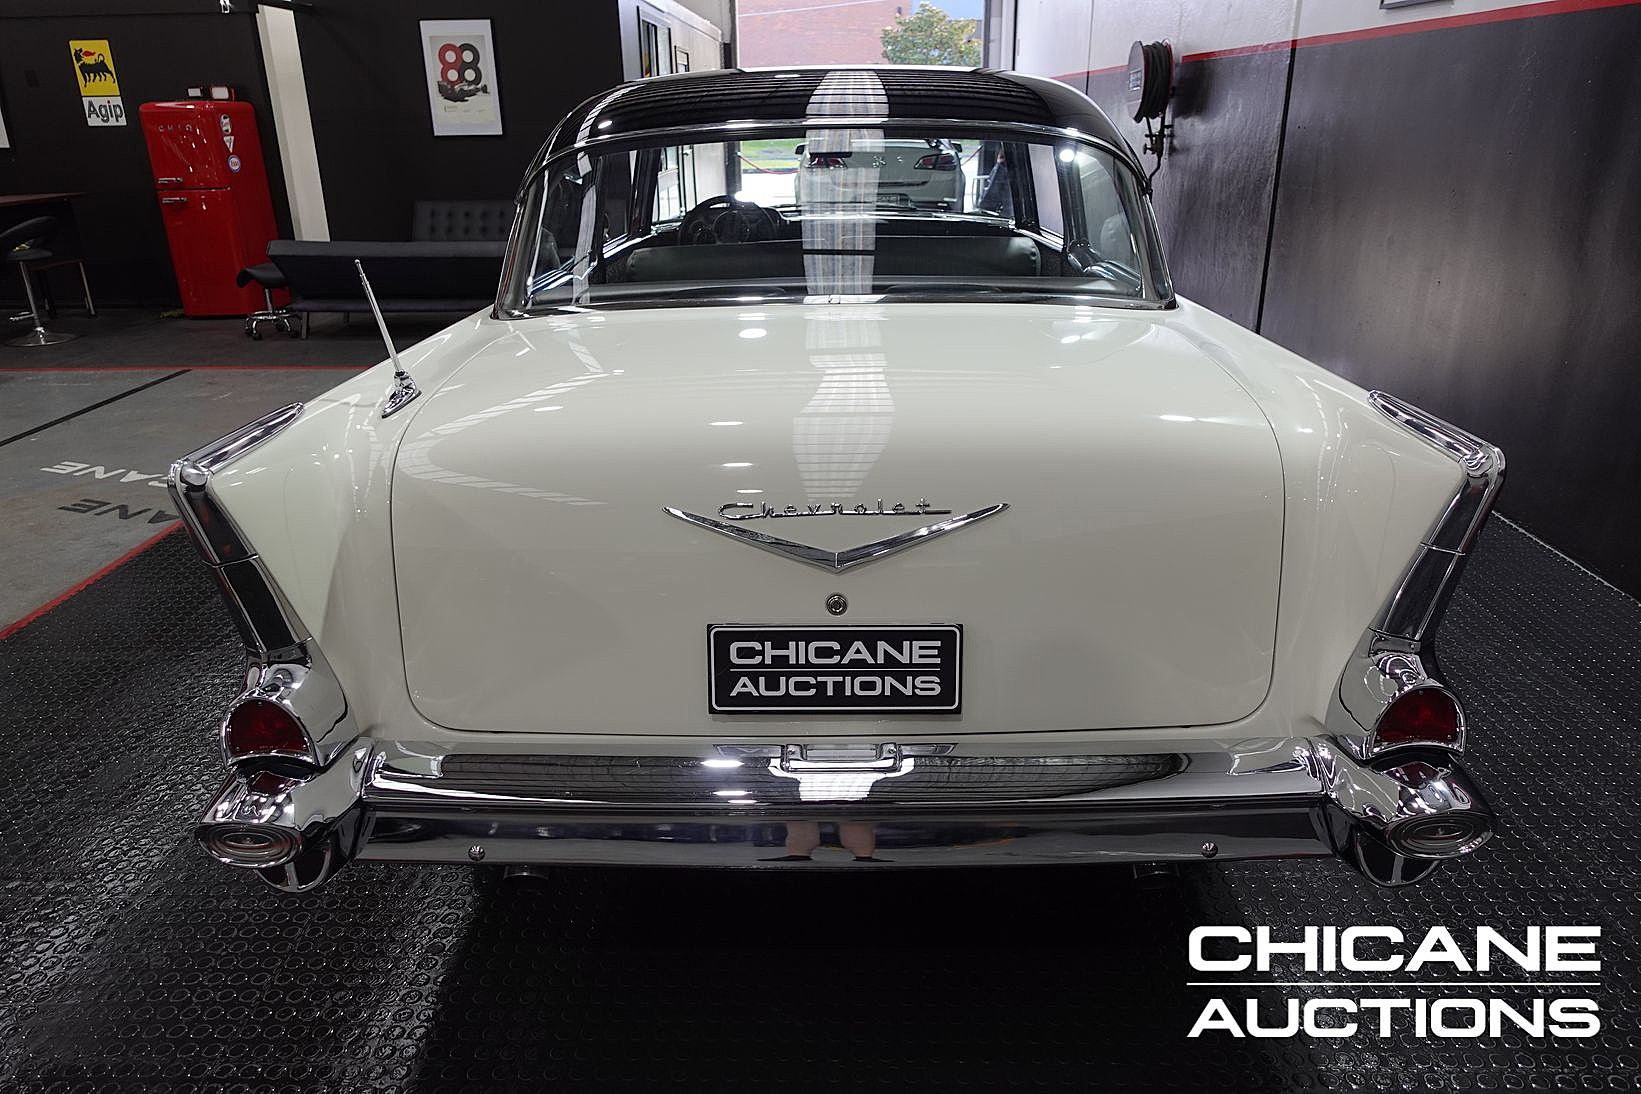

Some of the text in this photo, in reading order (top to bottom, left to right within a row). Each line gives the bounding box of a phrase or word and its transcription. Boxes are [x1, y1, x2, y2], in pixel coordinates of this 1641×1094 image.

[88, 100, 123, 123] Agip
[718, 498, 952, 520] Chevrolet
[729, 641, 942, 664] CHICANE
[729, 676, 941, 697] AUCTIONS
